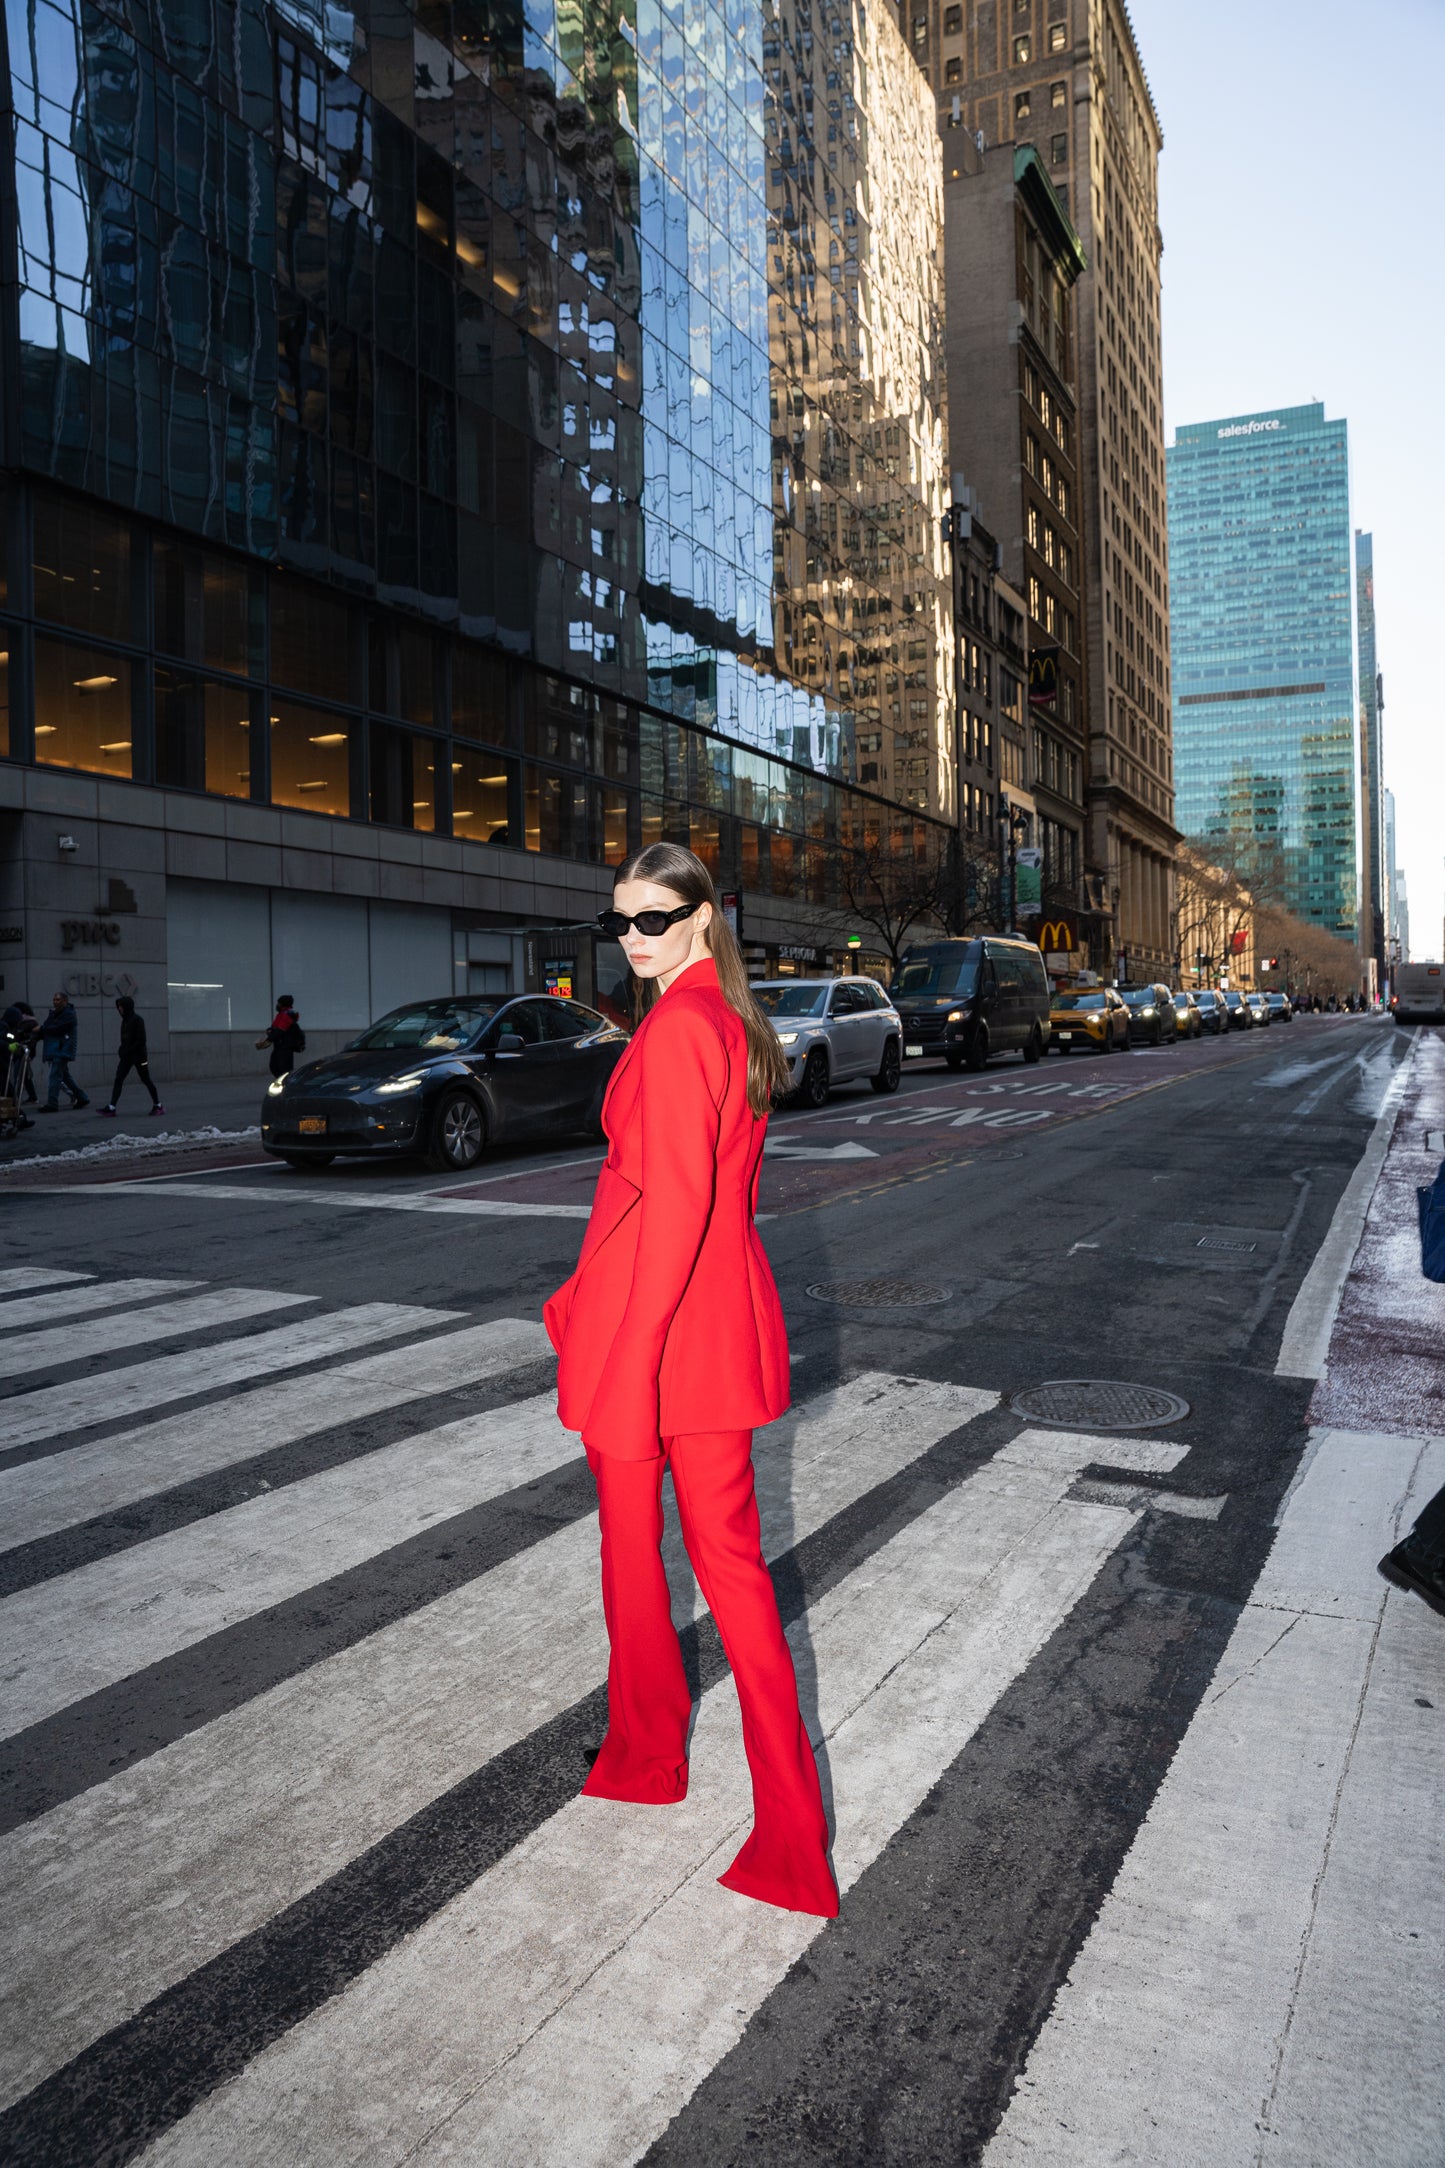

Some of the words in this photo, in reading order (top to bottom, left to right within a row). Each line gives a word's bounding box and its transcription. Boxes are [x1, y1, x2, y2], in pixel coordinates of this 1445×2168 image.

[1217, 419, 1280, 439] salesforce
[60, 920, 121, 951] pwc
[778, 945, 817, 961] SEPHORA
[63, 973, 115, 997] CIBC
[965, 1082, 1132, 1098] BUS
[807, 1106, 1056, 1128] ONLY
